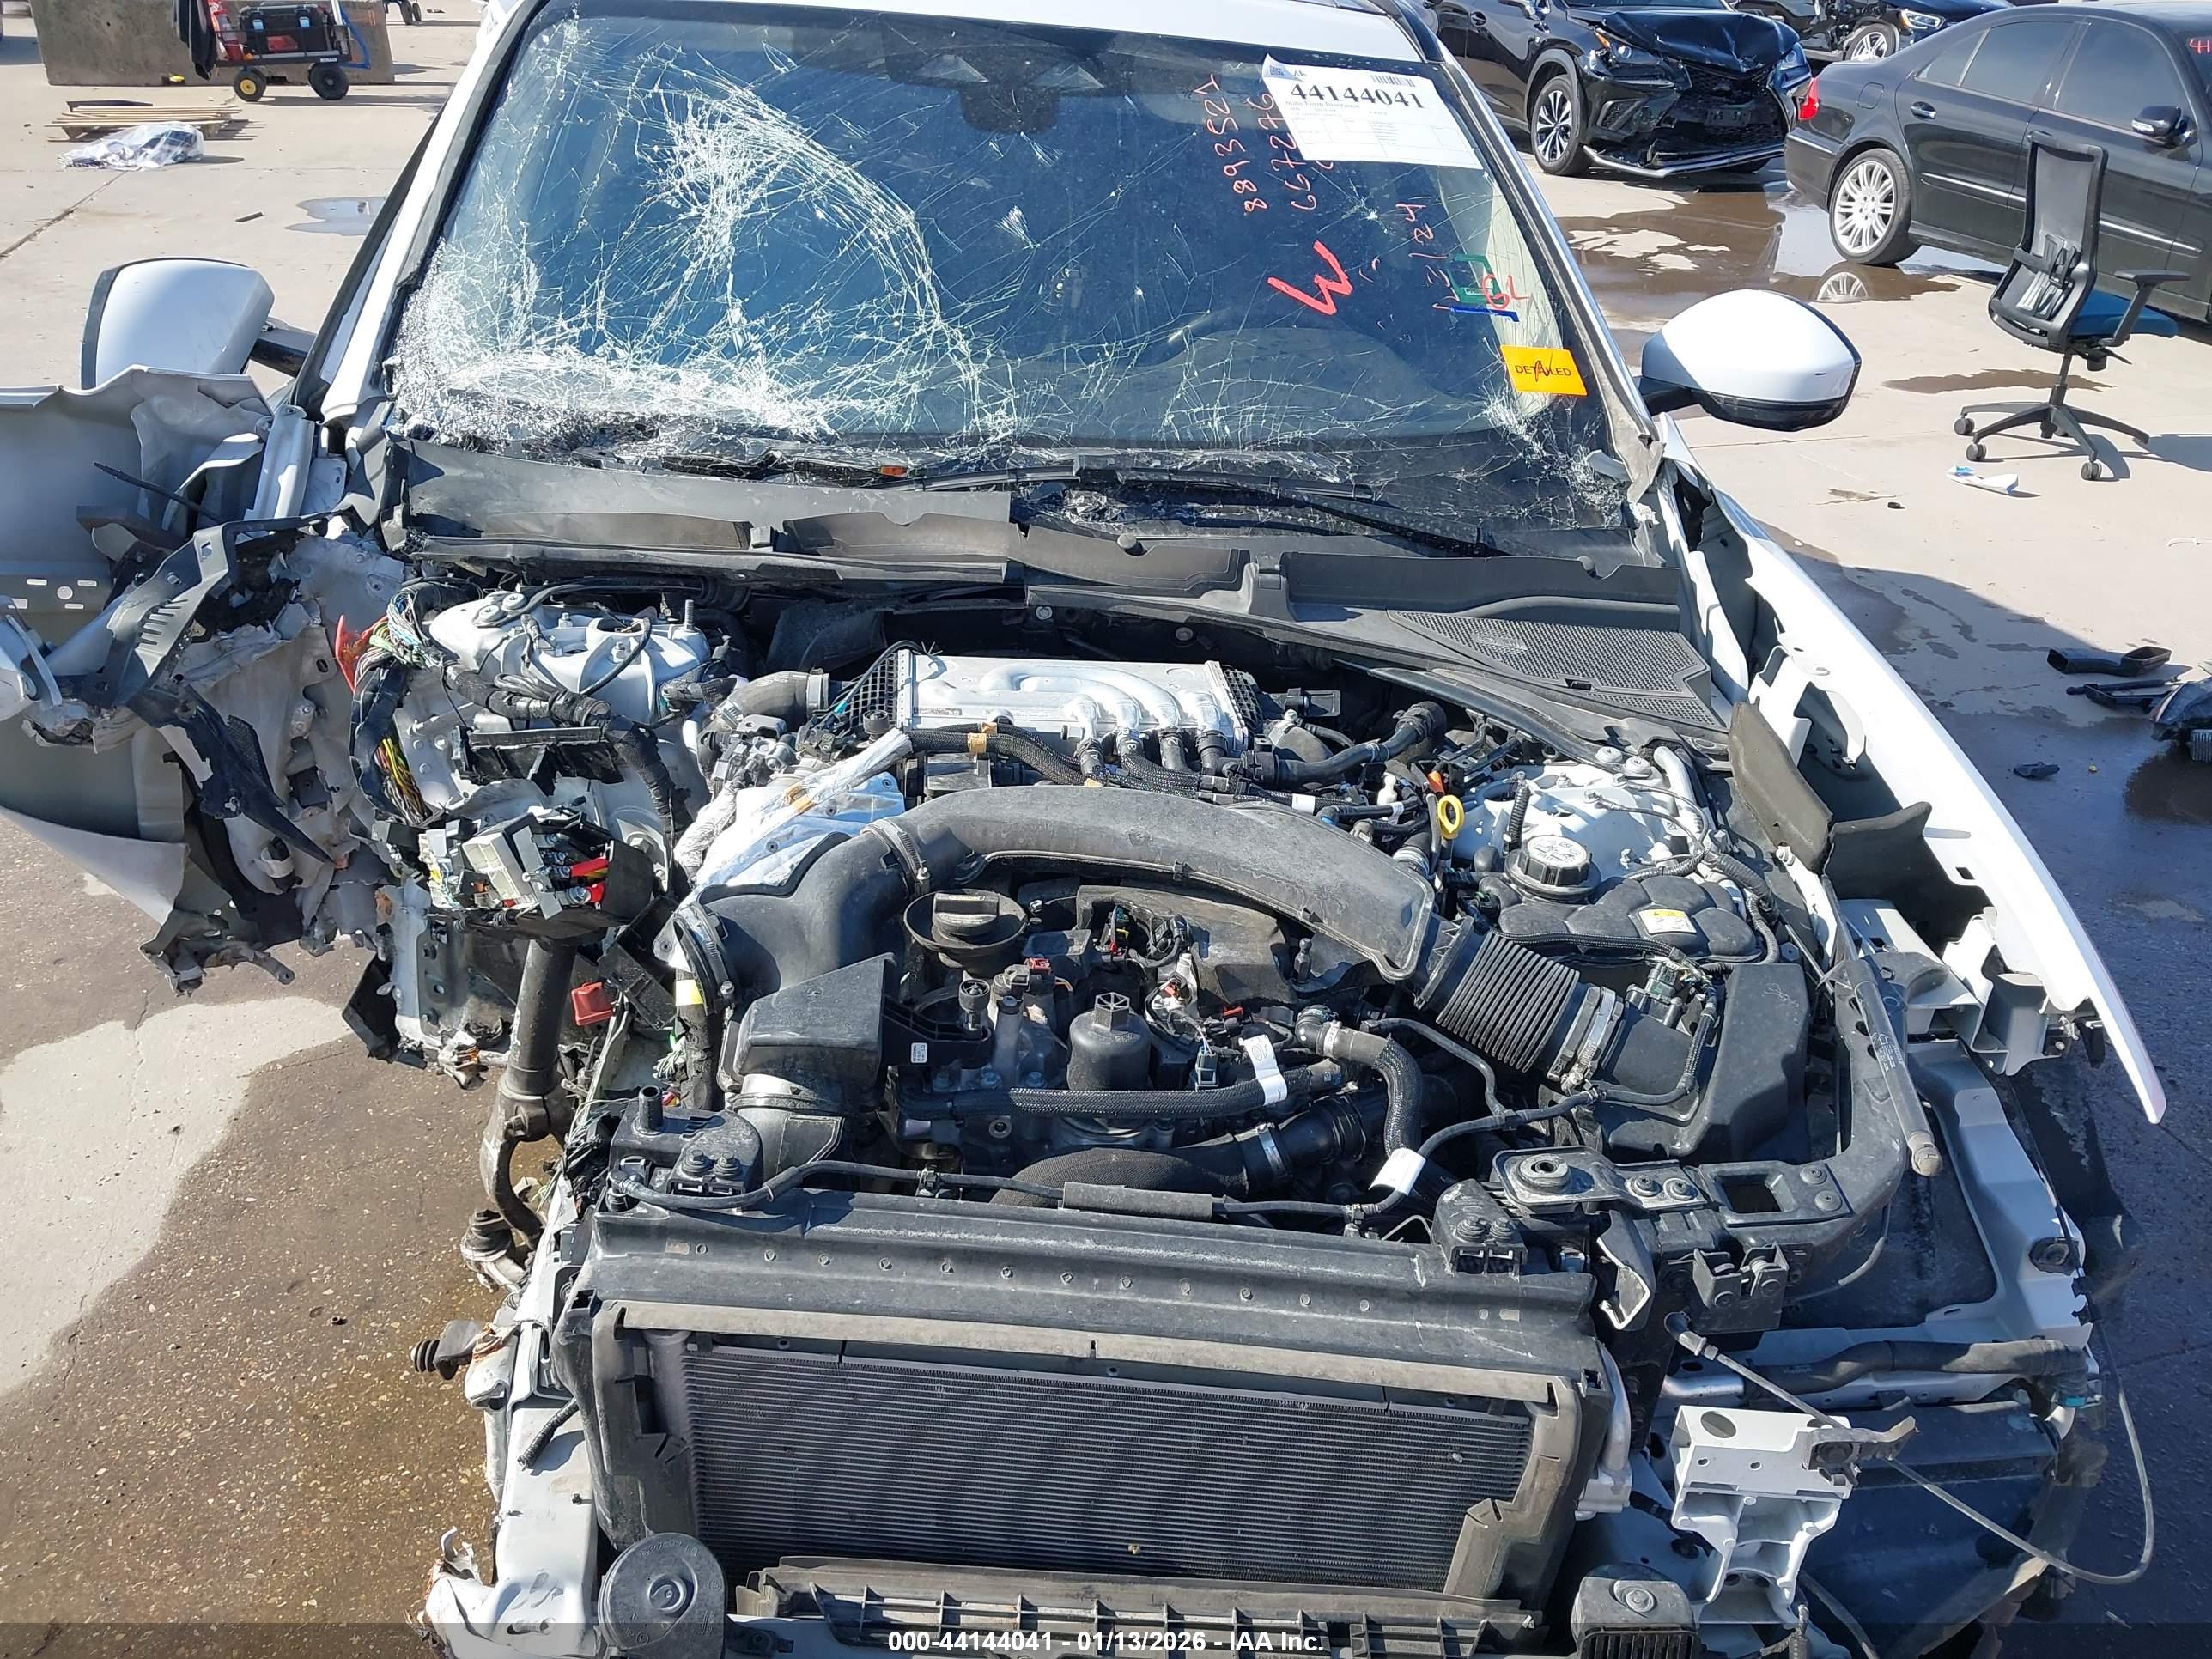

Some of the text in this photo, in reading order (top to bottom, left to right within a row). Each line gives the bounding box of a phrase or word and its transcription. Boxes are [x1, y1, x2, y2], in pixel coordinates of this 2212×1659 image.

[1291, 83, 1425, 109] 44144041
[1193, 74, 1269, 212] 8893521
[1515, 364, 1571, 376] DETAILED
